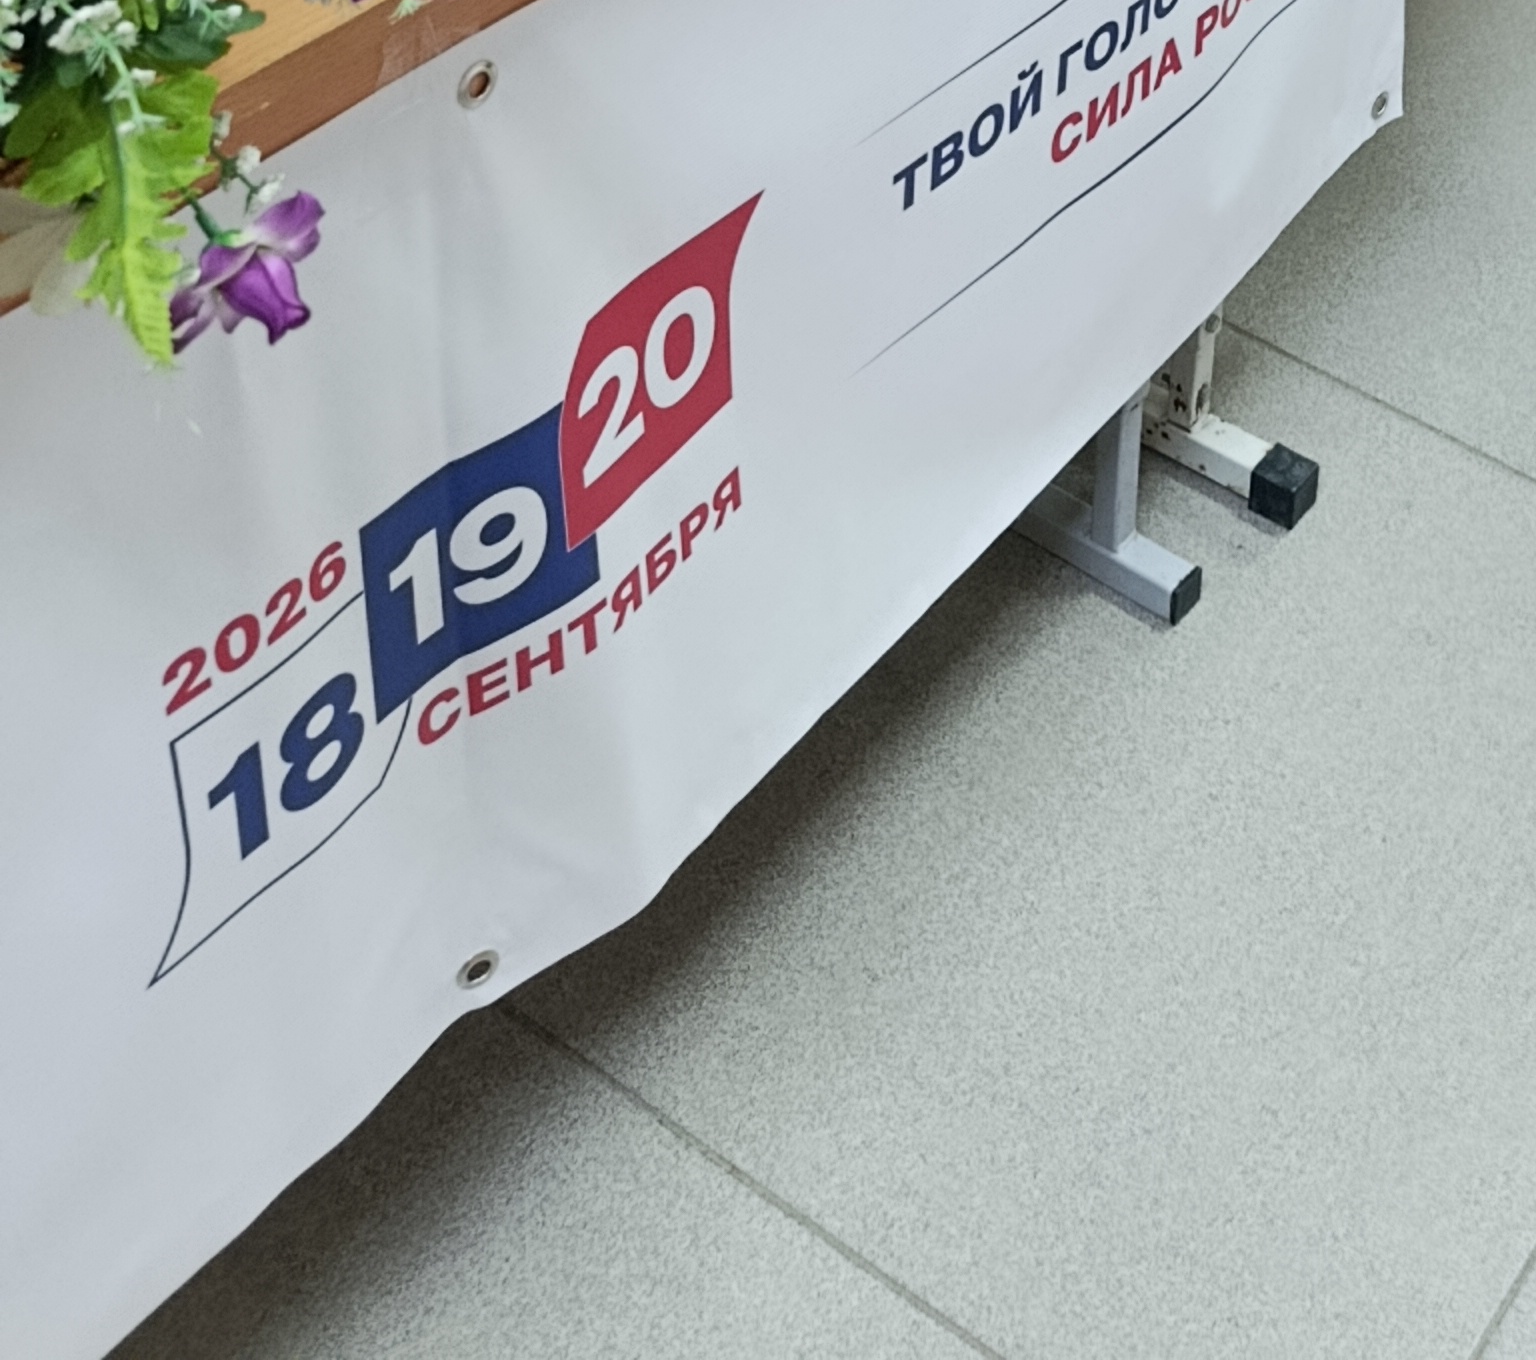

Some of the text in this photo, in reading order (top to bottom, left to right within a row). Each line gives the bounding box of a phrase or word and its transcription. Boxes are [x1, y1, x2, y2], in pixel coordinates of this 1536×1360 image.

[893, 59, 1044, 212] ТВОЙ
[1050, 37, 1183, 165] СИЛА
[161, 540, 347, 717] 2026
[206, 284, 717, 861] 18 19 20
[416, 464, 744, 746] СЕНТЯБРЯ
